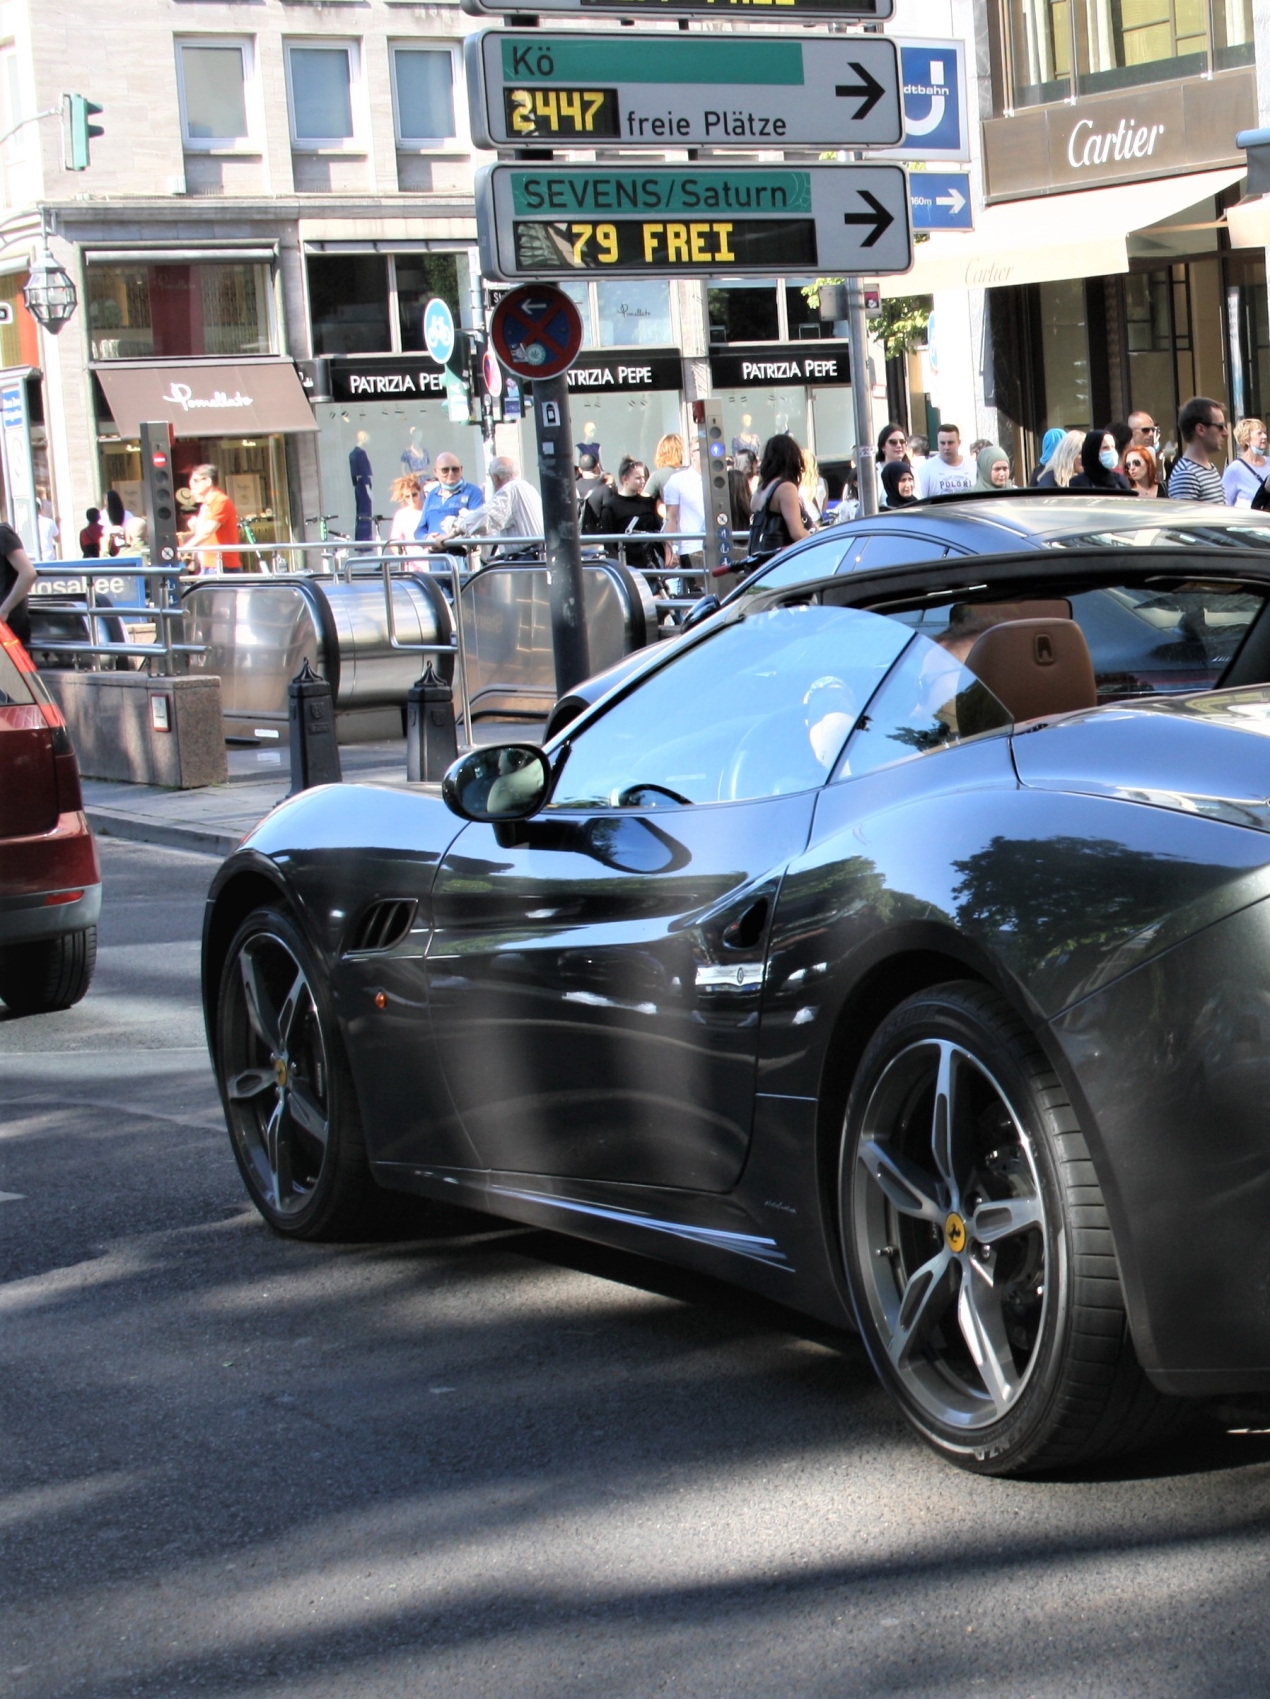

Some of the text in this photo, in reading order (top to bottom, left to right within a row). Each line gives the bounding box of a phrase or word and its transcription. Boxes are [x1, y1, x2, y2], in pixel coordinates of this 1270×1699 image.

[512, 46, 554, 76] Kö
[903, 84, 949, 96] dtbahn
[511, 90, 786, 136] 2447 freie Plätze
[1068, 119, 1164, 167] Cartier
[525, 179, 787, 209] SEVENS/Saturn
[572, 222, 736, 264] 79 FREI
[964, 257, 1014, 286] Cartier
[350, 373, 443, 394] PATRIZIA PE
[567, 366, 652, 386] TRIZIA PEPE
[742, 359, 838, 380] PATRIZIA PEPE
[163, 382, 254, 412] Pomellato
